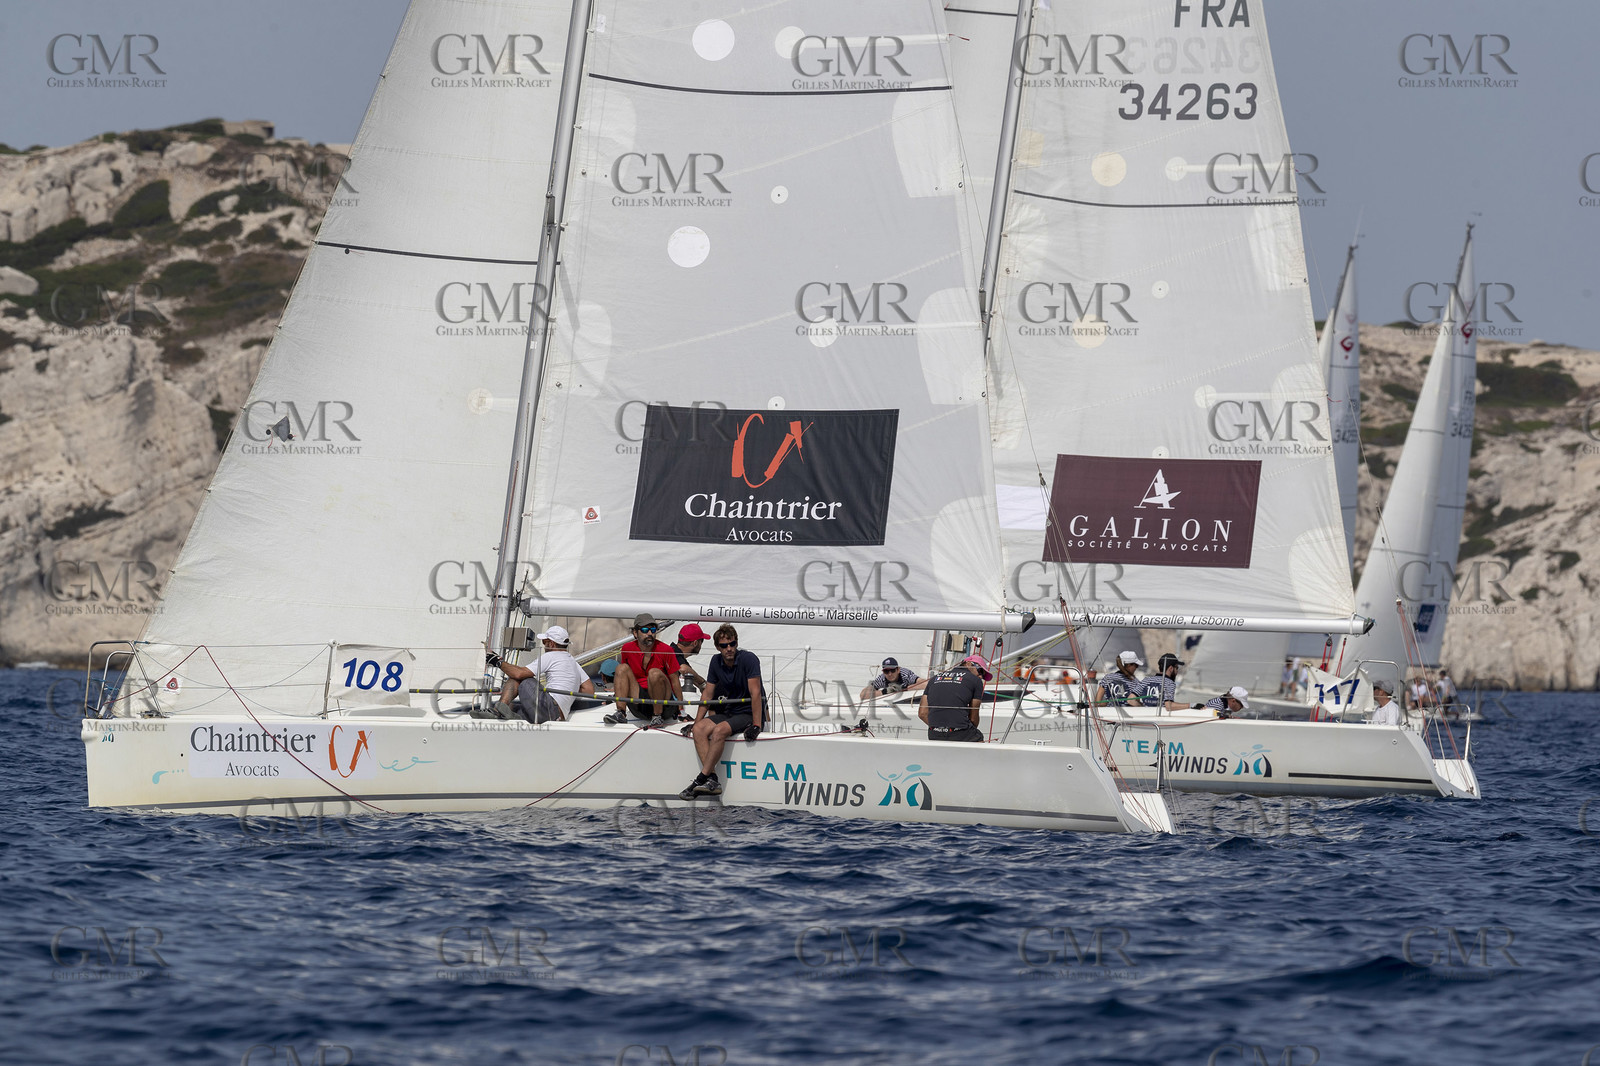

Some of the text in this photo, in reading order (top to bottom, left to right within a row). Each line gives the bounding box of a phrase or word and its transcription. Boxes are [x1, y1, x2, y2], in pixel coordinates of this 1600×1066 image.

[1174, 0, 1250, 28] FRA
[1118, 82, 1257, 120] 34263
[684, 493, 842, 522] Chaintrier
[725, 526, 794, 543] Avocats
[1069, 514, 1232, 543] GALION
[1143, 542, 1228, 553] D'AVOCATS
[700, 606, 713, 617] La
[718, 606, 752, 618] Trinité
[763, 607, 815, 619] Lisbonne
[827, 609, 878, 621] Marseille
[1132, 615, 1186, 626] Marseille,
[1191, 615, 1244, 627] Lisbonne
[343, 657, 403, 692] 108
[1315, 679, 1360, 704] 117
[190, 724, 316, 754] Chaintrier
[225, 761, 280, 778] Avocats
[720, 760, 807, 782] TEAM
[1169, 756, 1229, 774] WINDS
[784, 782, 866, 808] WINDS
